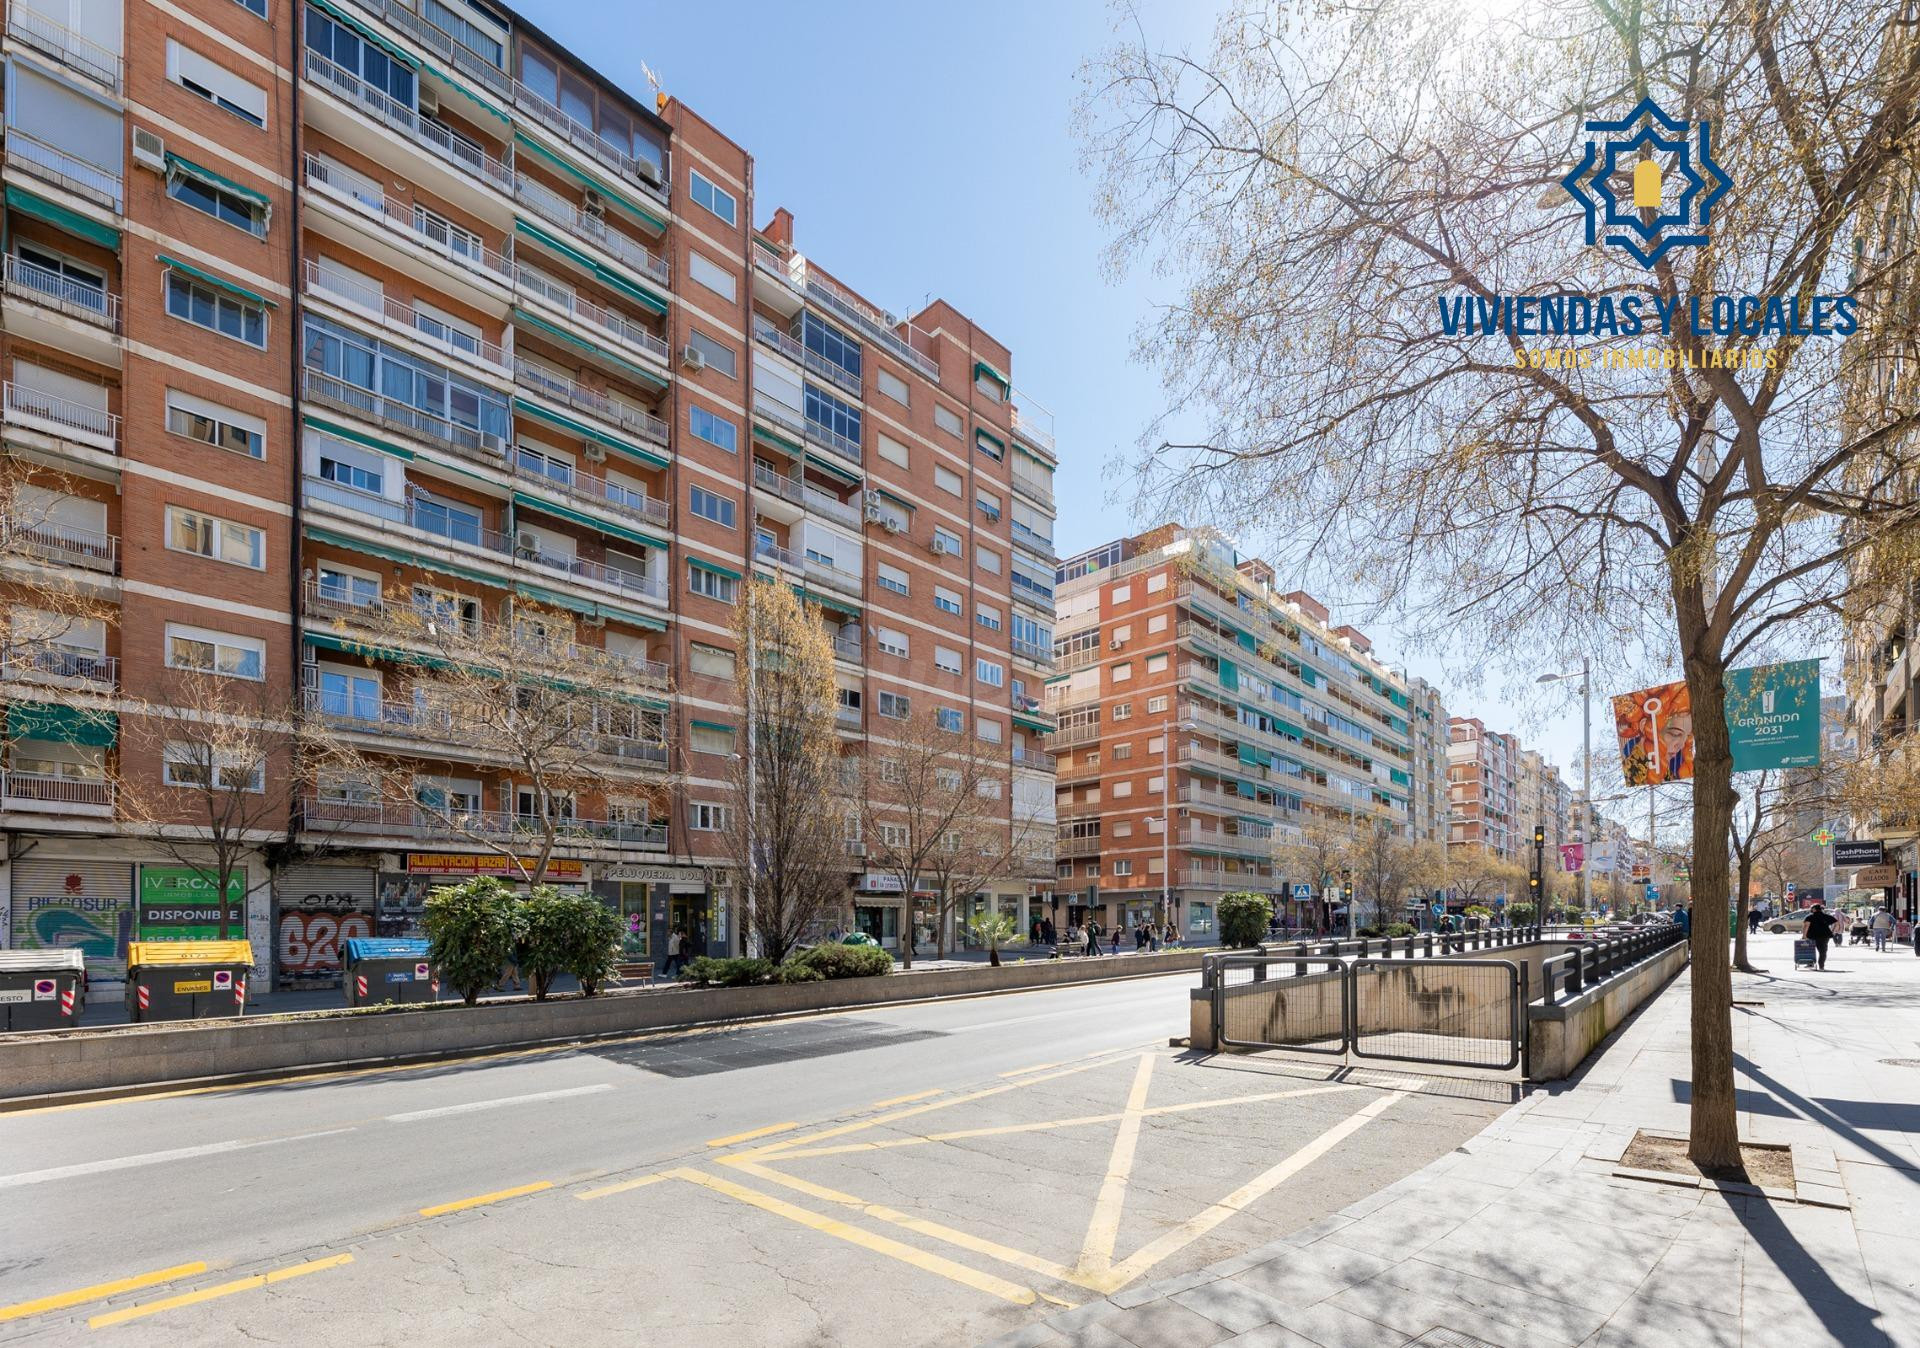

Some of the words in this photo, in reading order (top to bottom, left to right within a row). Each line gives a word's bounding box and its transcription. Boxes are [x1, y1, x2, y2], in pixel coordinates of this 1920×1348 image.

[1738, 712, 1800, 728] GRANADA
[1755, 725, 1783, 736] 2031
[1835, 848, 1880, 857] CashPhone
[477, 856, 507, 868] BAZAR
[144, 877, 241, 889] IVERCAA
[148, 910, 239, 920] DISPONIBE
